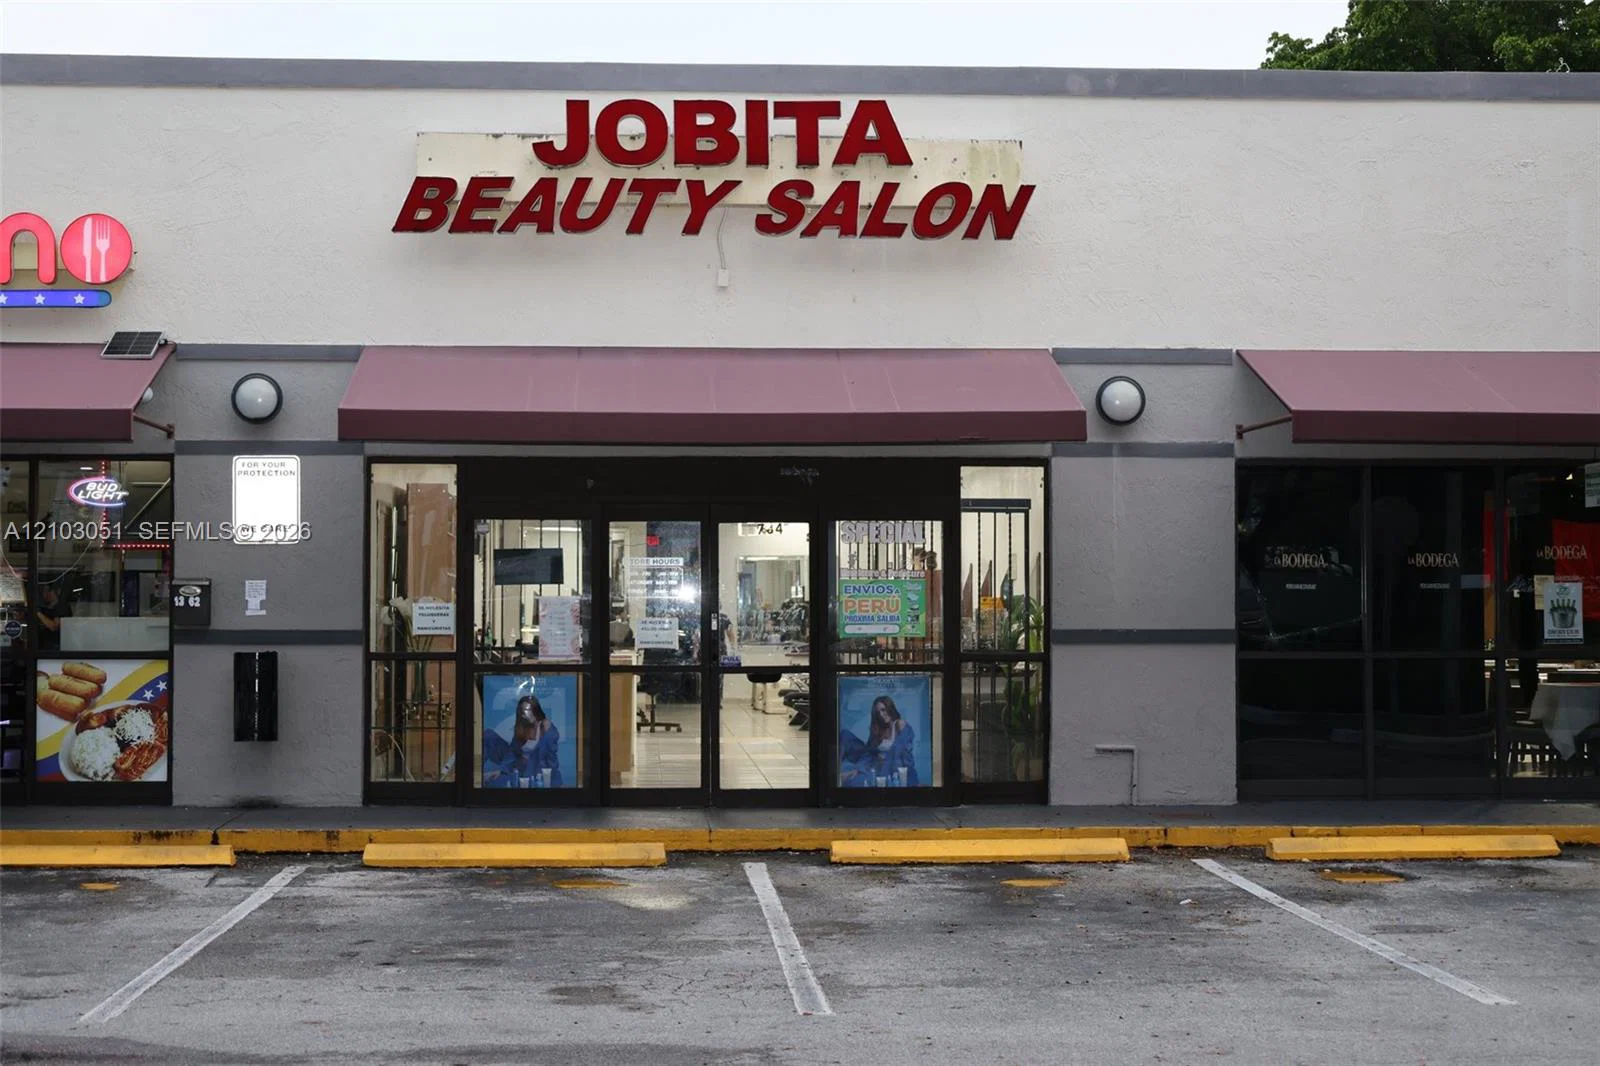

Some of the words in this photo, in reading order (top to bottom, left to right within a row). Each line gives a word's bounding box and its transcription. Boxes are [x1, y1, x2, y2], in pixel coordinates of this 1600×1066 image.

[532, 98, 914, 168] JOBITA
[392, 176, 743, 236] BEAUTY
[755, 180, 1036, 241] SALON
[237, 469, 296, 477] PROTECTION
[85, 481, 119, 492] BUD
[76, 489, 130, 500] LIGHT
[841, 521, 926, 544] SPECIAL
[1282, 552, 1326, 568] BODEGA
[1416, 552, 1460, 568] BODEGA
[1544, 545, 1588, 560] BODEGA
[843, 584, 894, 595] ENVIOS
[843, 594, 901, 615] PERÚ
[876, 615, 900, 623] SALIDA
